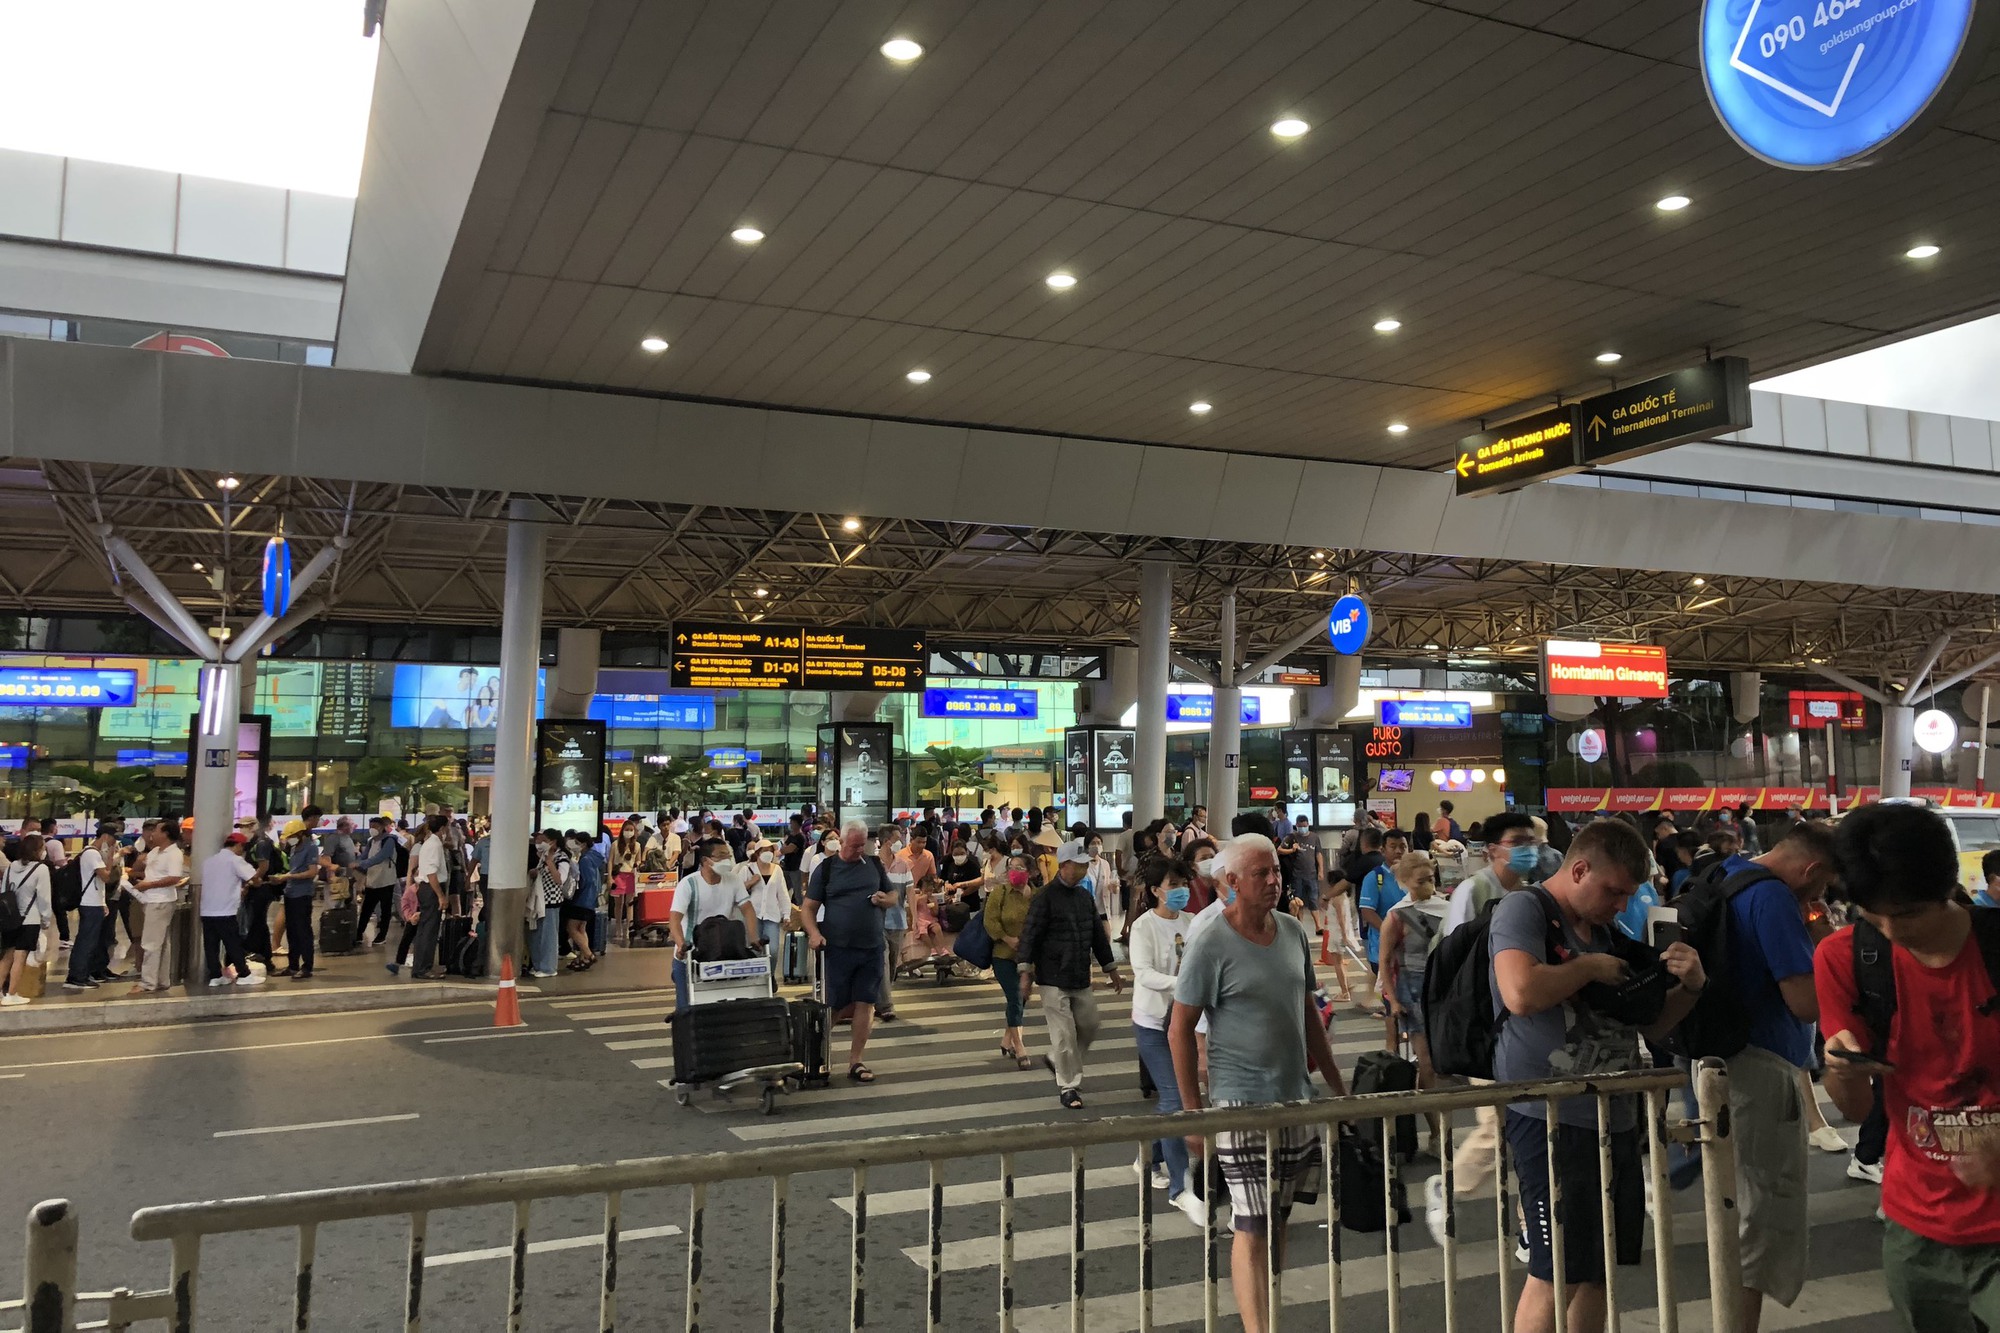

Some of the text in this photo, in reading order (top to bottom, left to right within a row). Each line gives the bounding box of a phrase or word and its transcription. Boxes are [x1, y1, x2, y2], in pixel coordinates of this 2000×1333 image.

[1760, 15, 1805, 58] 090
[1612, 388, 1676, 420] GA QUỐC TẾ
[1613, 400, 1714, 436] International Terminal
[1477, 422, 1571, 459] GA ĐẾN TRONG NƯỚC
[1478, 447, 1544, 473] Domestic Arrivals
[1331, 619, 1352, 635] VIB
[703, 632, 718, 640] ĐẾN
[742, 634, 761, 642] NƯỚC
[764, 637, 799, 648] A1-A3
[816, 634, 835, 642] QUỐC
[835, 635, 844, 643] TẾ
[733, 658, 753, 666] NƯỚC
[763, 662, 799, 673] D1-D4
[873, 666, 906, 676] D5-D8
[1551, 663, 1665, 686] Homtamin Ginseng
[1373, 727, 1401, 740] PURO
[1366, 741, 1402, 757] GUSTO
[207, 750, 229, 766] A-09
[1933, 1111, 1969, 1126] 2nd
